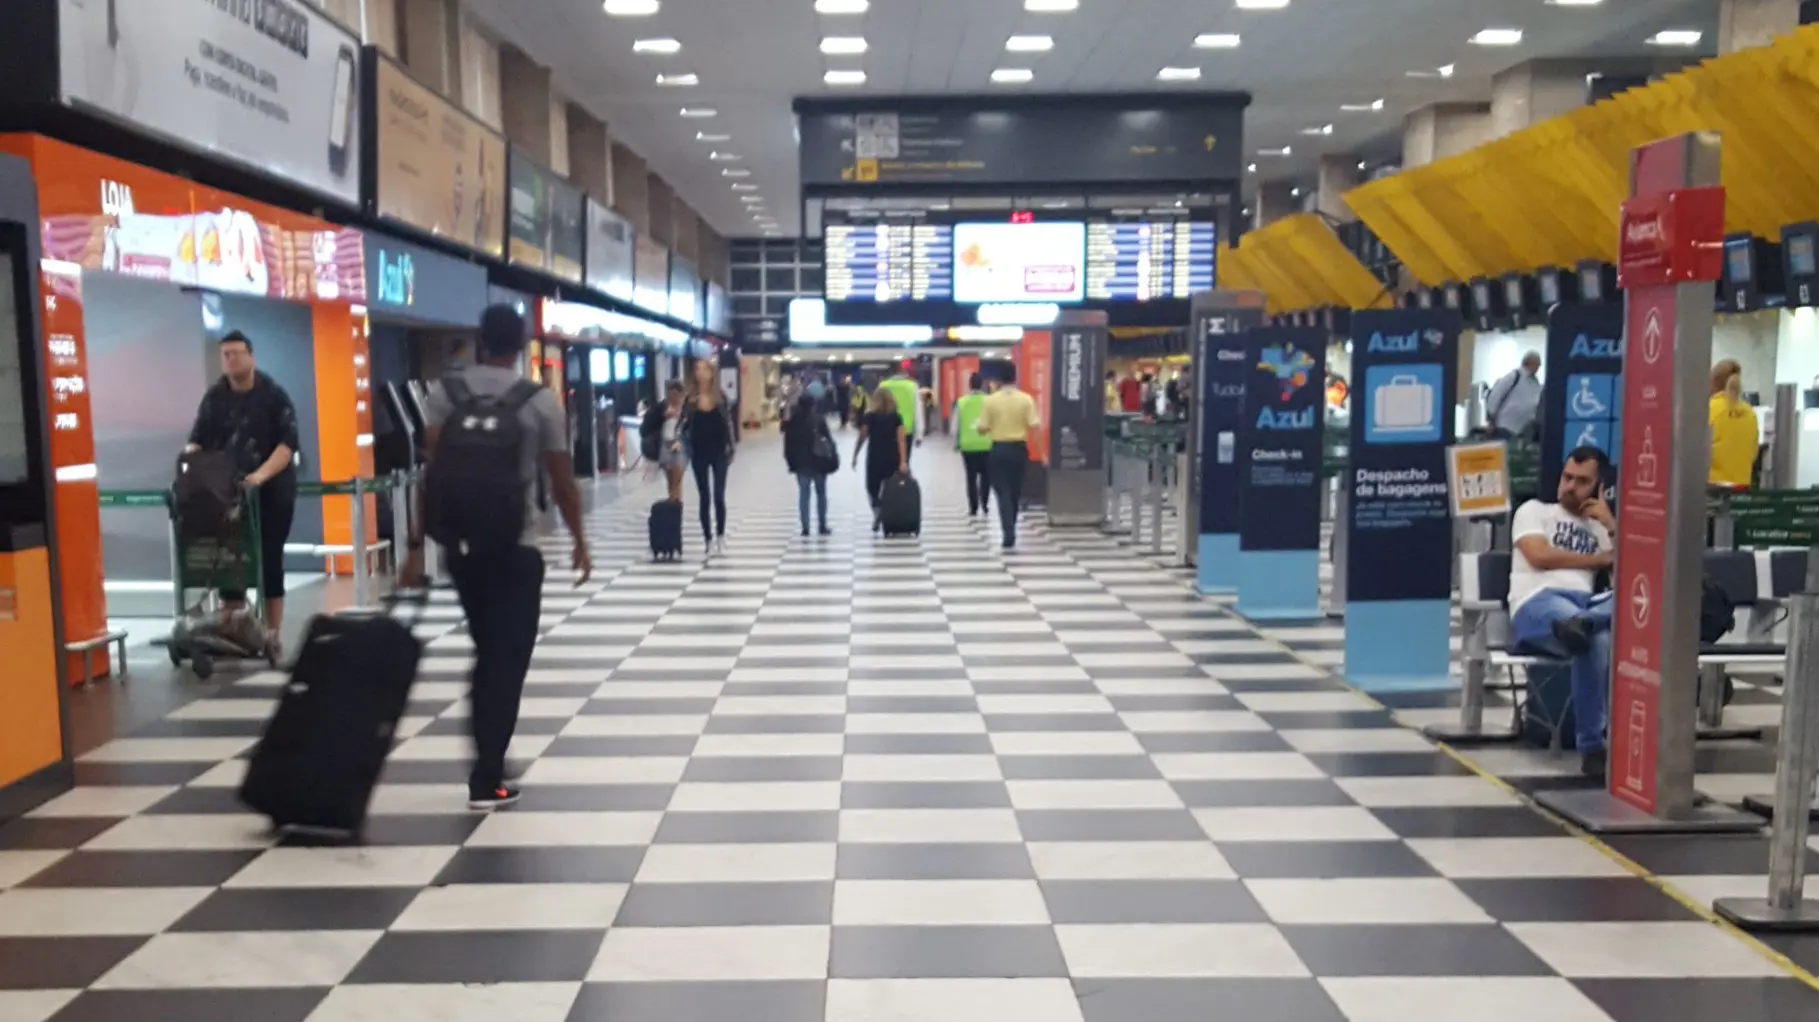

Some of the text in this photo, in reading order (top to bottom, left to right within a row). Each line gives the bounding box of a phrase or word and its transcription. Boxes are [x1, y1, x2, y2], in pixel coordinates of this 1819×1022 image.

[100, 178, 134, 216] LOJA
[378, 249, 405, 304] Azul
[1367, 329, 1418, 353] Azul
[1568, 333, 1623, 359] Azu
[1256, 405, 1315, 430] Azul
[1251, 448, 1303, 461] Check-in
[1355, 467, 1429, 484] Despacho
[1355, 483, 1447, 498] de bagagens
